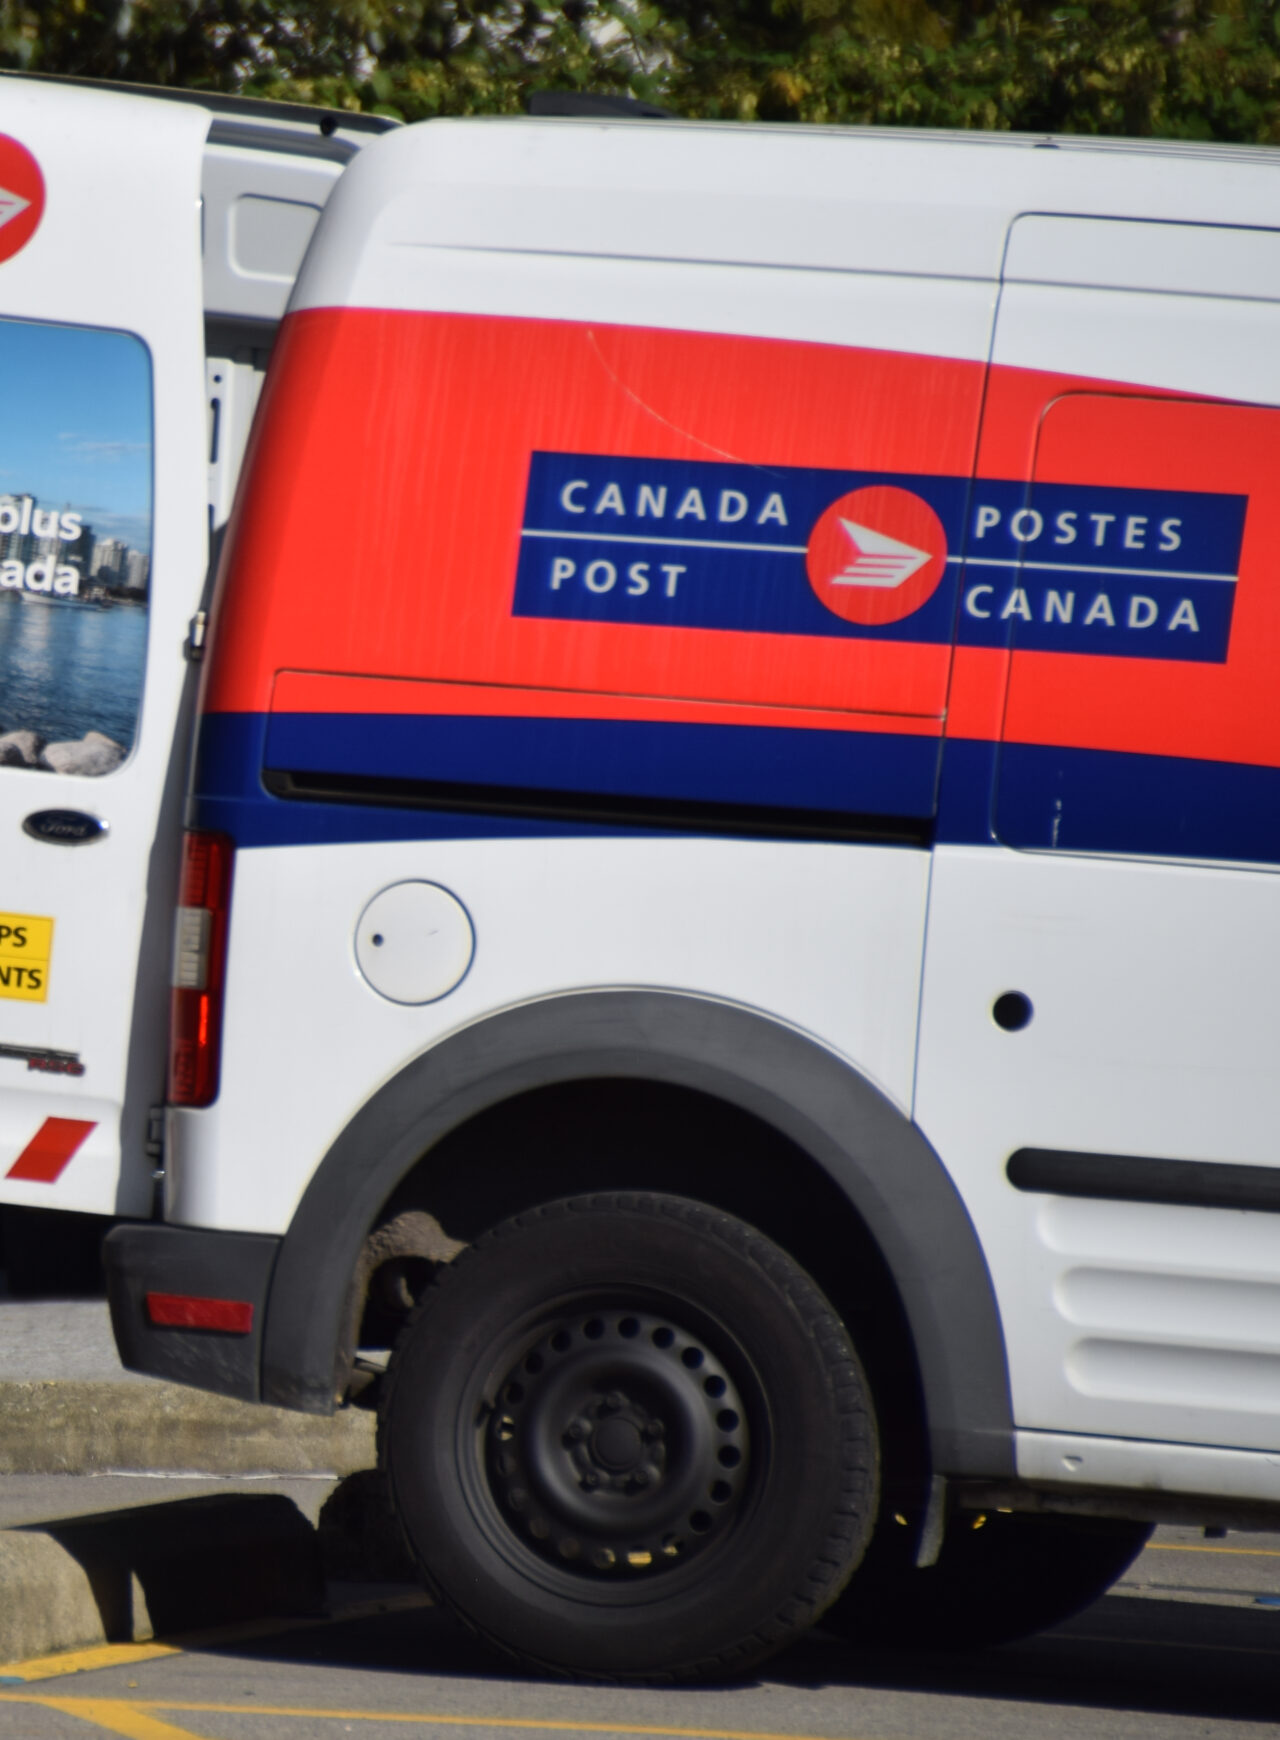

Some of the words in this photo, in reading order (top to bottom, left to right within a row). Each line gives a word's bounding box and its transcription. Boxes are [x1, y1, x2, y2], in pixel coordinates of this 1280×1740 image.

[560, 480, 789, 526] CANADA
[974, 506, 1183, 552] POSTES
[550, 557, 687, 598] POST
[965, 584, 1200, 633] CANADA
